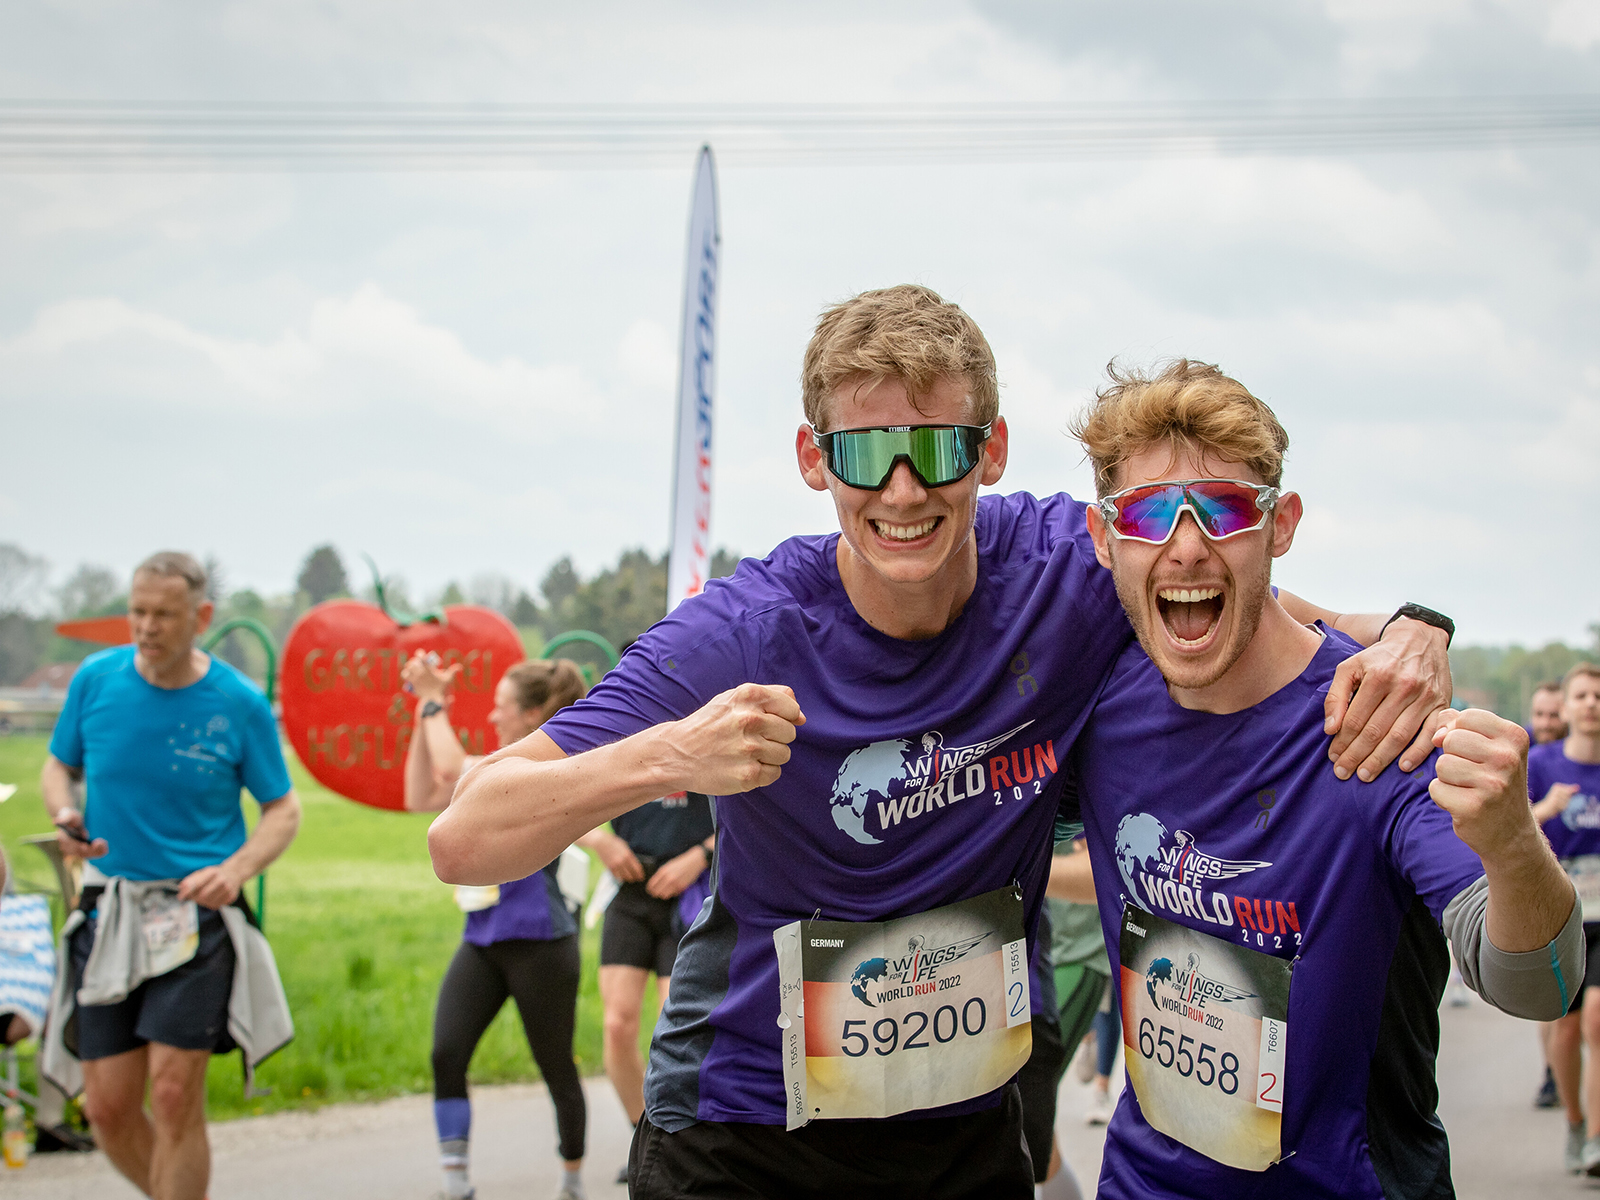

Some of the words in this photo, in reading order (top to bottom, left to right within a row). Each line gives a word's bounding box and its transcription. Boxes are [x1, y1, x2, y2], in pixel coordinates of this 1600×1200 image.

[904, 778, 922, 788] FOR
[994, 780, 1042, 805] 202
[1157, 863, 1170, 873] FOR
[1169, 866, 1204, 889] LIFE
[810, 938, 844, 948] GERMANY
[1242, 928, 1302, 949] 2022
[1010, 942, 1020, 975] T5513
[889, 972, 903, 980] FOR
[901, 965, 939, 984] LIFE
[939, 974, 961, 991] 2022
[1171, 982, 1182, 991] FOR
[1179, 986, 1209, 1009] LIFE
[1008, 981, 1027, 1017] 2
[841, 997, 986, 1057] 59200
[1205, 1013, 1224, 1031] 2022
[1267, 1020, 1278, 1053] T6607
[789, 1033, 799, 1069] T5513
[1138, 1017, 1240, 1095] 65558
[793, 1081, 804, 1116] 59200
[1259, 1072, 1281, 1104] 2
